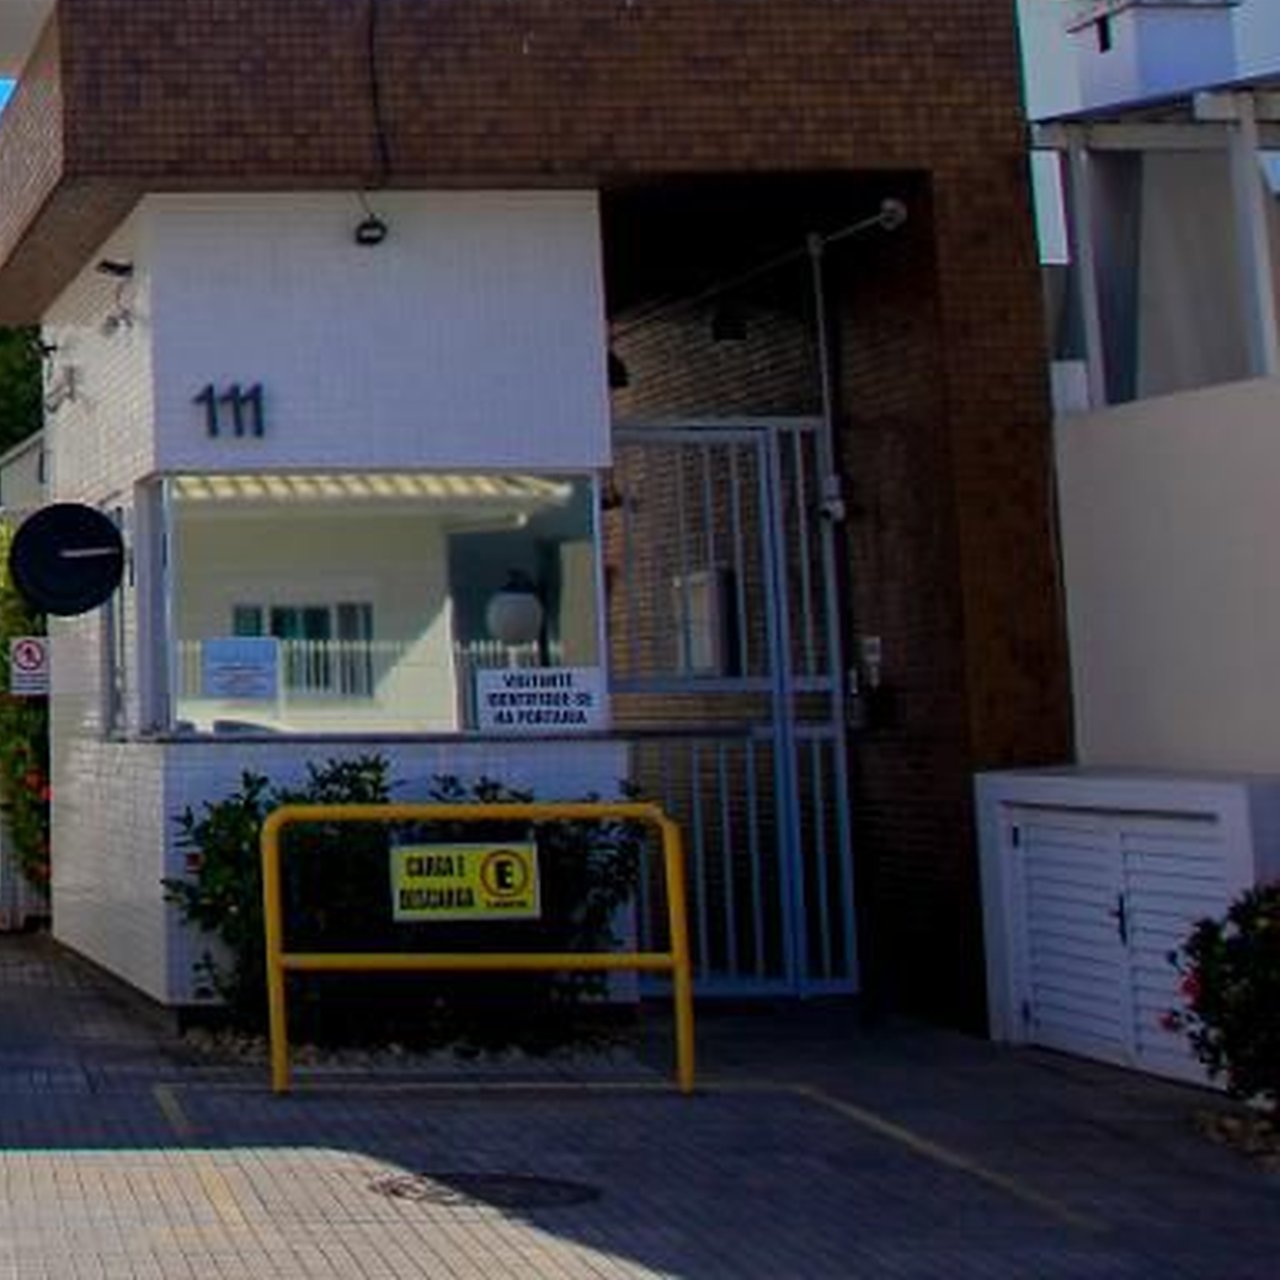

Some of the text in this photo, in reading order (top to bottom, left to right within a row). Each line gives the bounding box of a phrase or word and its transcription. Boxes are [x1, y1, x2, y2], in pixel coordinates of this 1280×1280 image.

[192, 382, 265, 438] 111
[502, 672, 573, 689] VISITANTE
[405, 854, 454, 878] CARGA
[399, 887, 475, 911] DESCARGA
